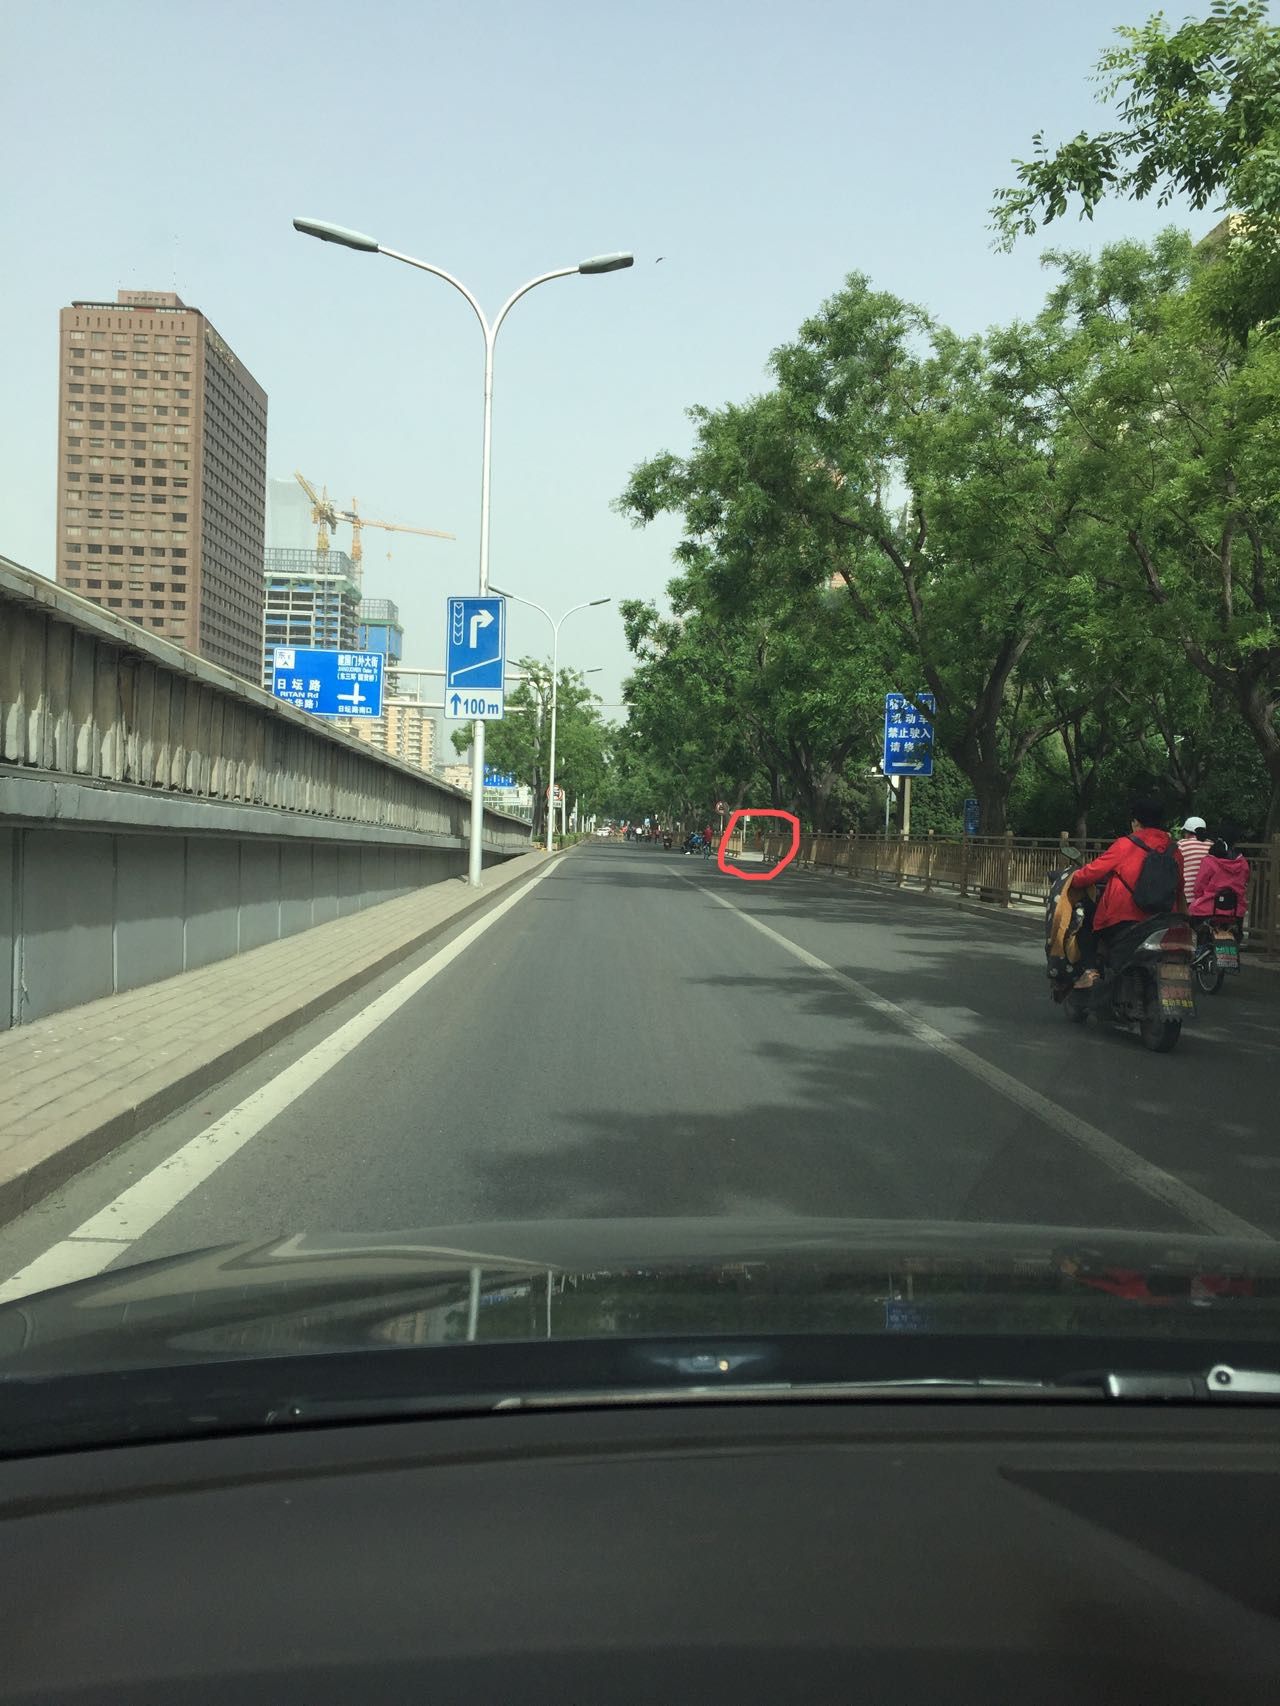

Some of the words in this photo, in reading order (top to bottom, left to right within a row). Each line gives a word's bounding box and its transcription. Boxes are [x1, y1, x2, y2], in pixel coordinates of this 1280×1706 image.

[278, 678, 320, 691] 日坛路
[887, 727, 931, 739] 禁止驶入
